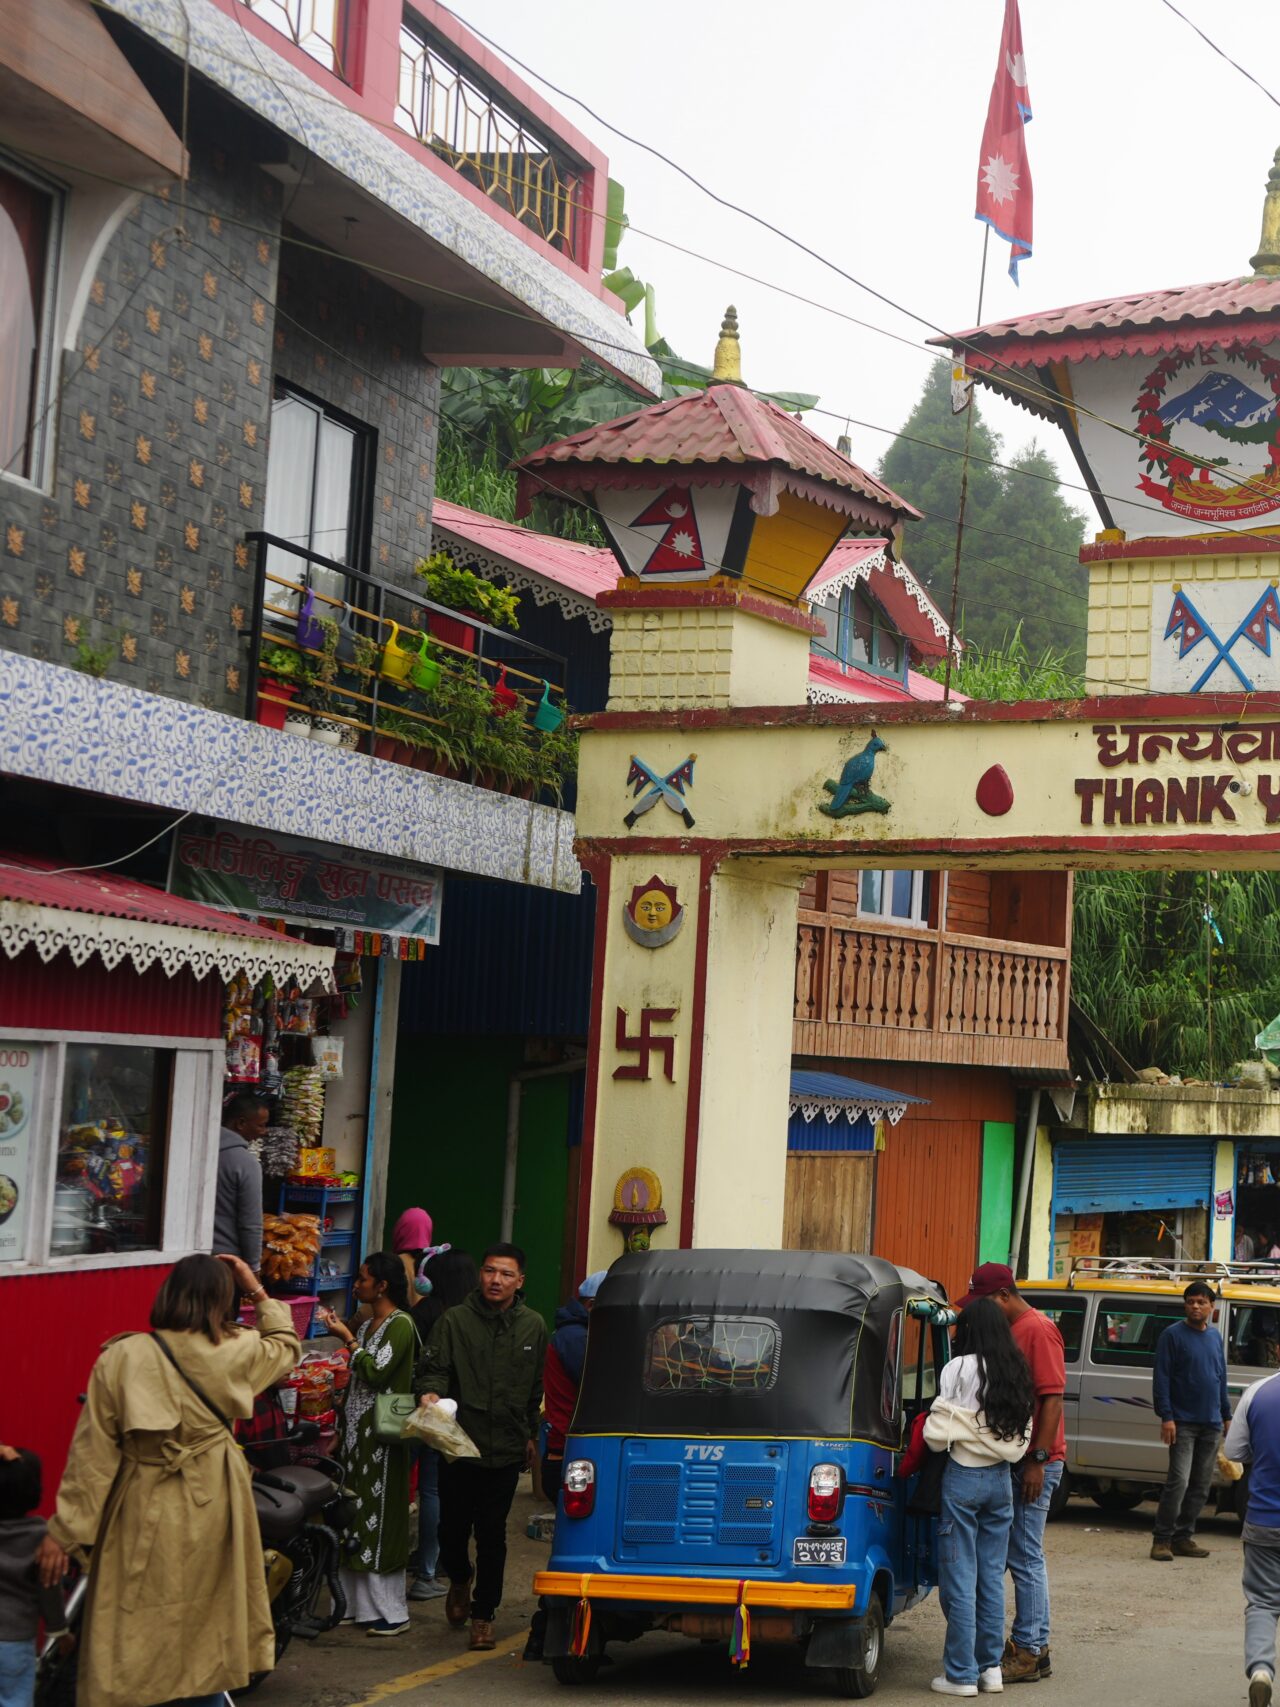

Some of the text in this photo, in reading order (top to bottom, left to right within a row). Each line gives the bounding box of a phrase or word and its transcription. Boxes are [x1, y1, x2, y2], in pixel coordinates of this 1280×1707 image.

[1075, 775, 1236, 825] THANK
[316, 860, 371, 900] खुद्रा
[376, 872, 437, 908] पसल
[684, 1445, 726, 1460] TVS
